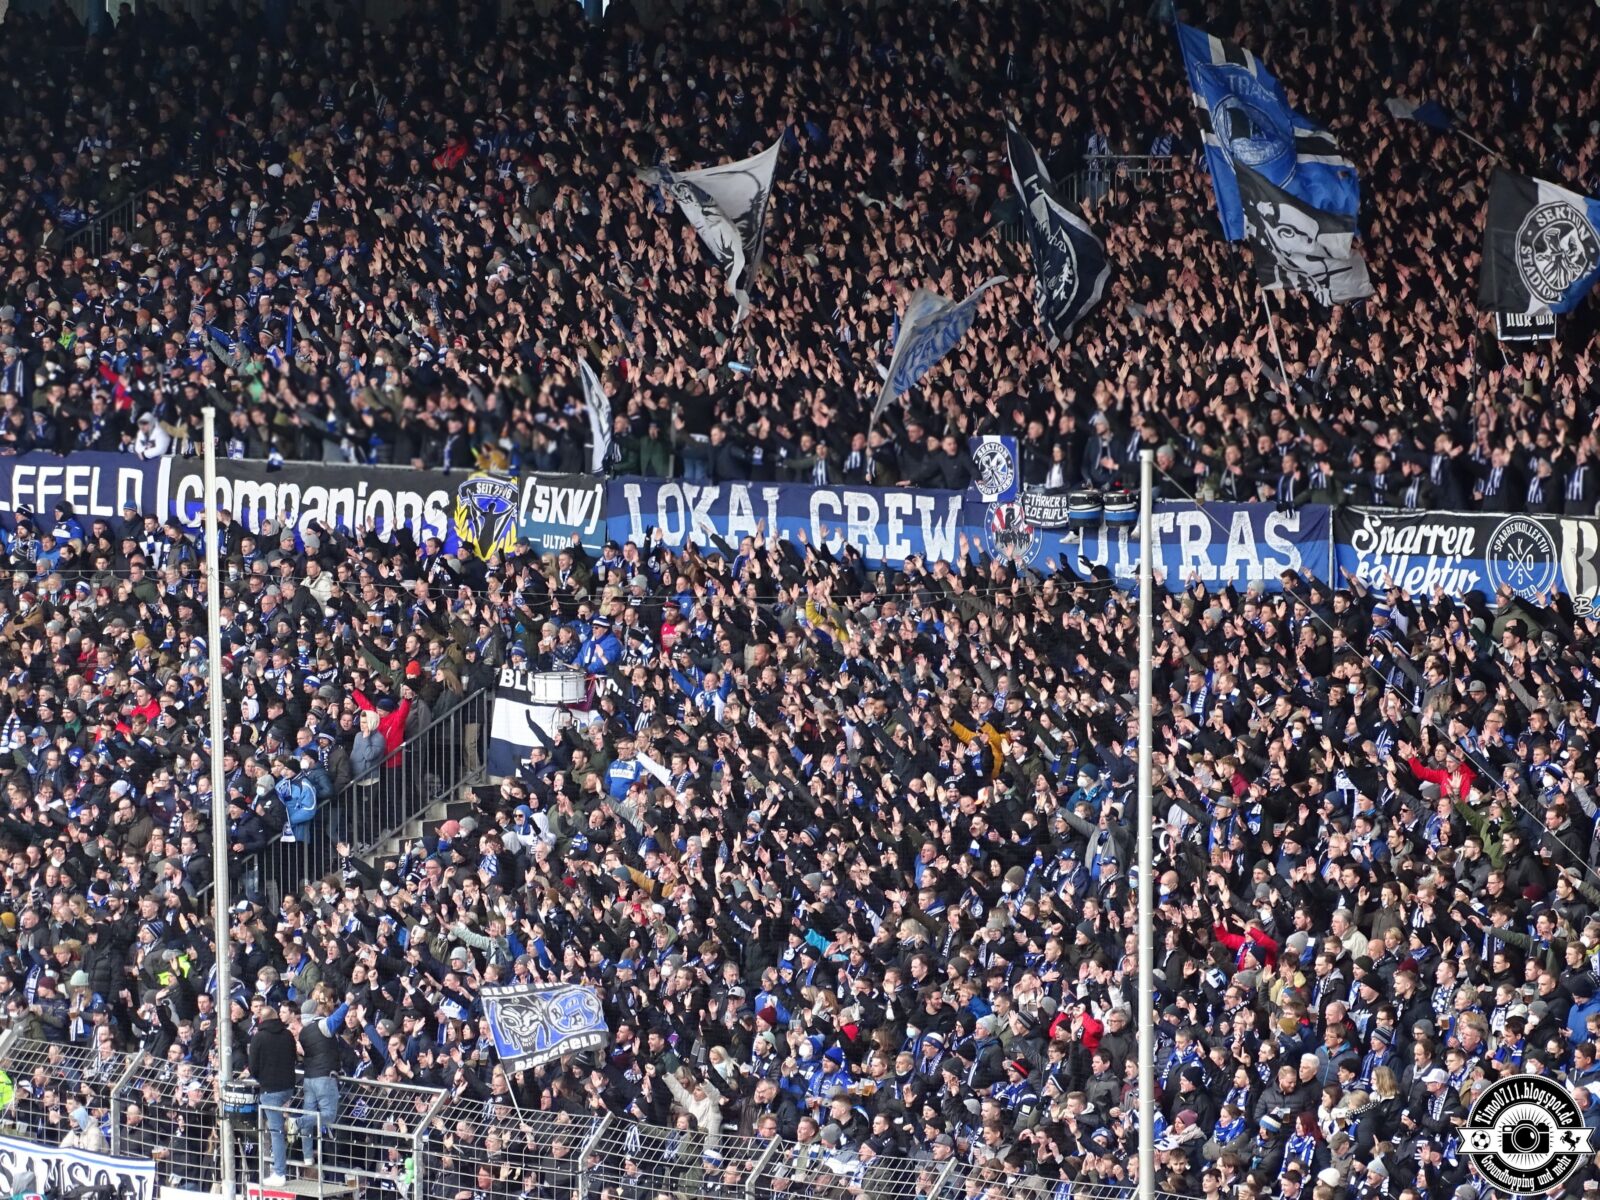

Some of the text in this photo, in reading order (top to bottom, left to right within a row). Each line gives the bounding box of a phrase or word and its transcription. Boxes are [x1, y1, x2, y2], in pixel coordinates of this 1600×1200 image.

[1536, 206, 1592, 241] SEKTION
[977, 443, 1010, 459] SEKTION
[0, 465, 143, 517] EFELD
[476, 482, 494, 495] SEIT
[624, 483, 962, 563] LOKAL CREW
[1042, 507, 1068, 521] AUFLA
[543, 534, 575, 550] ULTRA
[1078, 511, 1302, 581] ULTRAS
[1352, 514, 1476, 564] Sparren
[1493, 521, 1551, 553] SPARRENKOLLEKTIV
